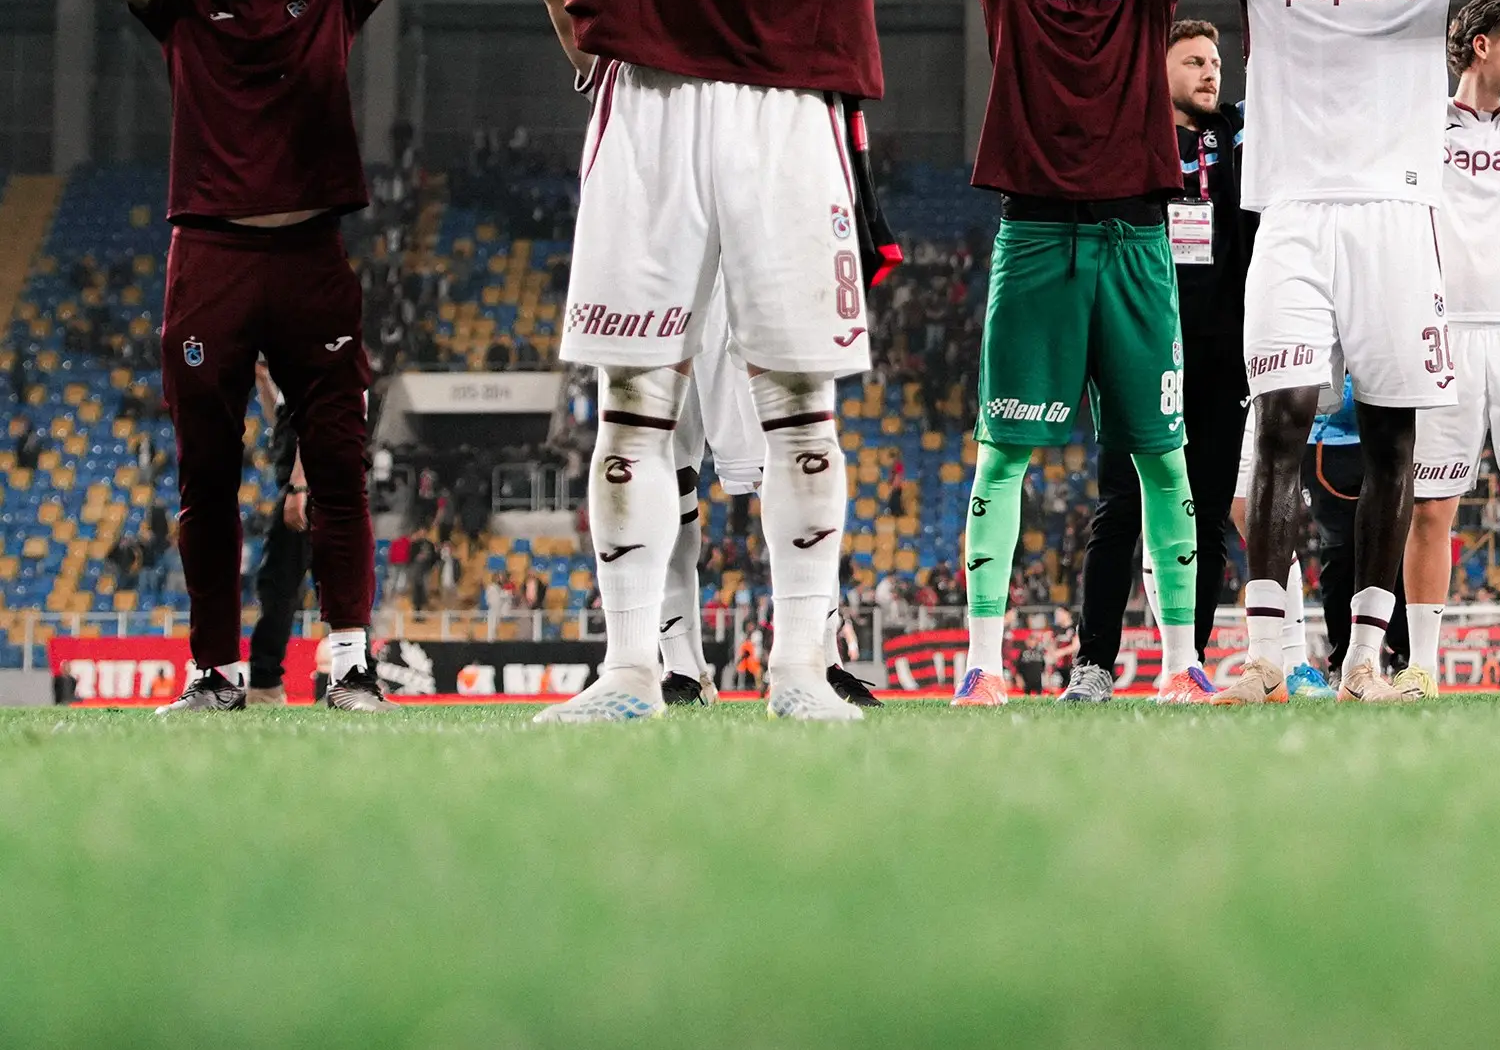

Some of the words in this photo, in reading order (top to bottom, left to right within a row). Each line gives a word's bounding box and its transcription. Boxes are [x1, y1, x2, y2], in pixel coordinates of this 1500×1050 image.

[834, 250, 860, 319] 8
[582, 304, 655, 337] Rent
[657, 306, 692, 337] Go
[1249, 350, 1289, 380] Rent
[1293, 344, 1313, 366] Go
[1002, 398, 1047, 421] Rent
[1044, 402, 1071, 422] Go
[1413, 462, 1448, 480] Rent
[1449, 462, 1470, 480] Go
